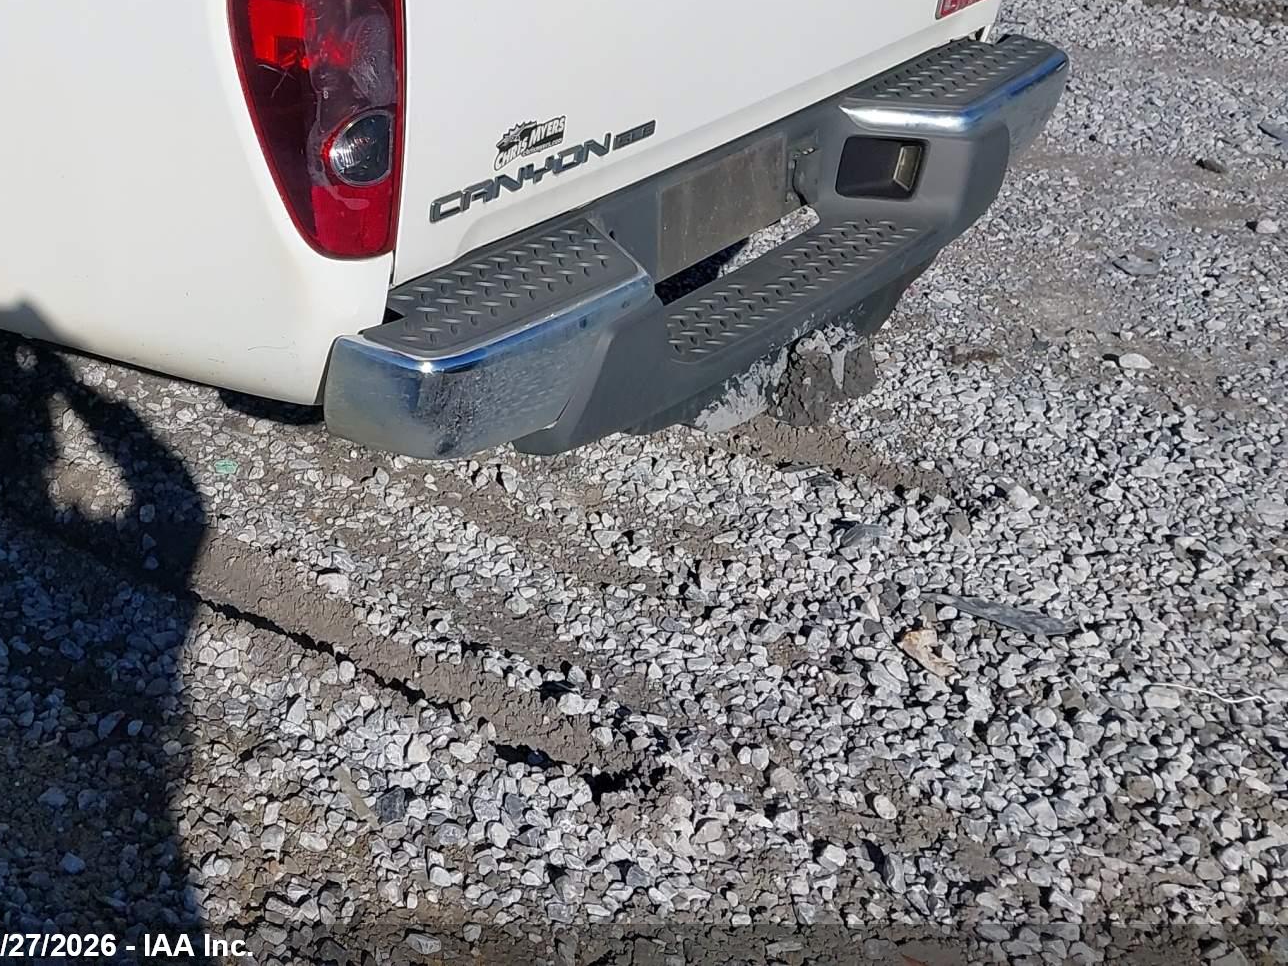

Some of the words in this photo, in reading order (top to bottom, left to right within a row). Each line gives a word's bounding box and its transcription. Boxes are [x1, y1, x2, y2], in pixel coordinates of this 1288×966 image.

[429, 132, 611, 223] CANYON
[495, 137, 528, 169] CHRIS
[528, 117, 566, 148] MYERS
